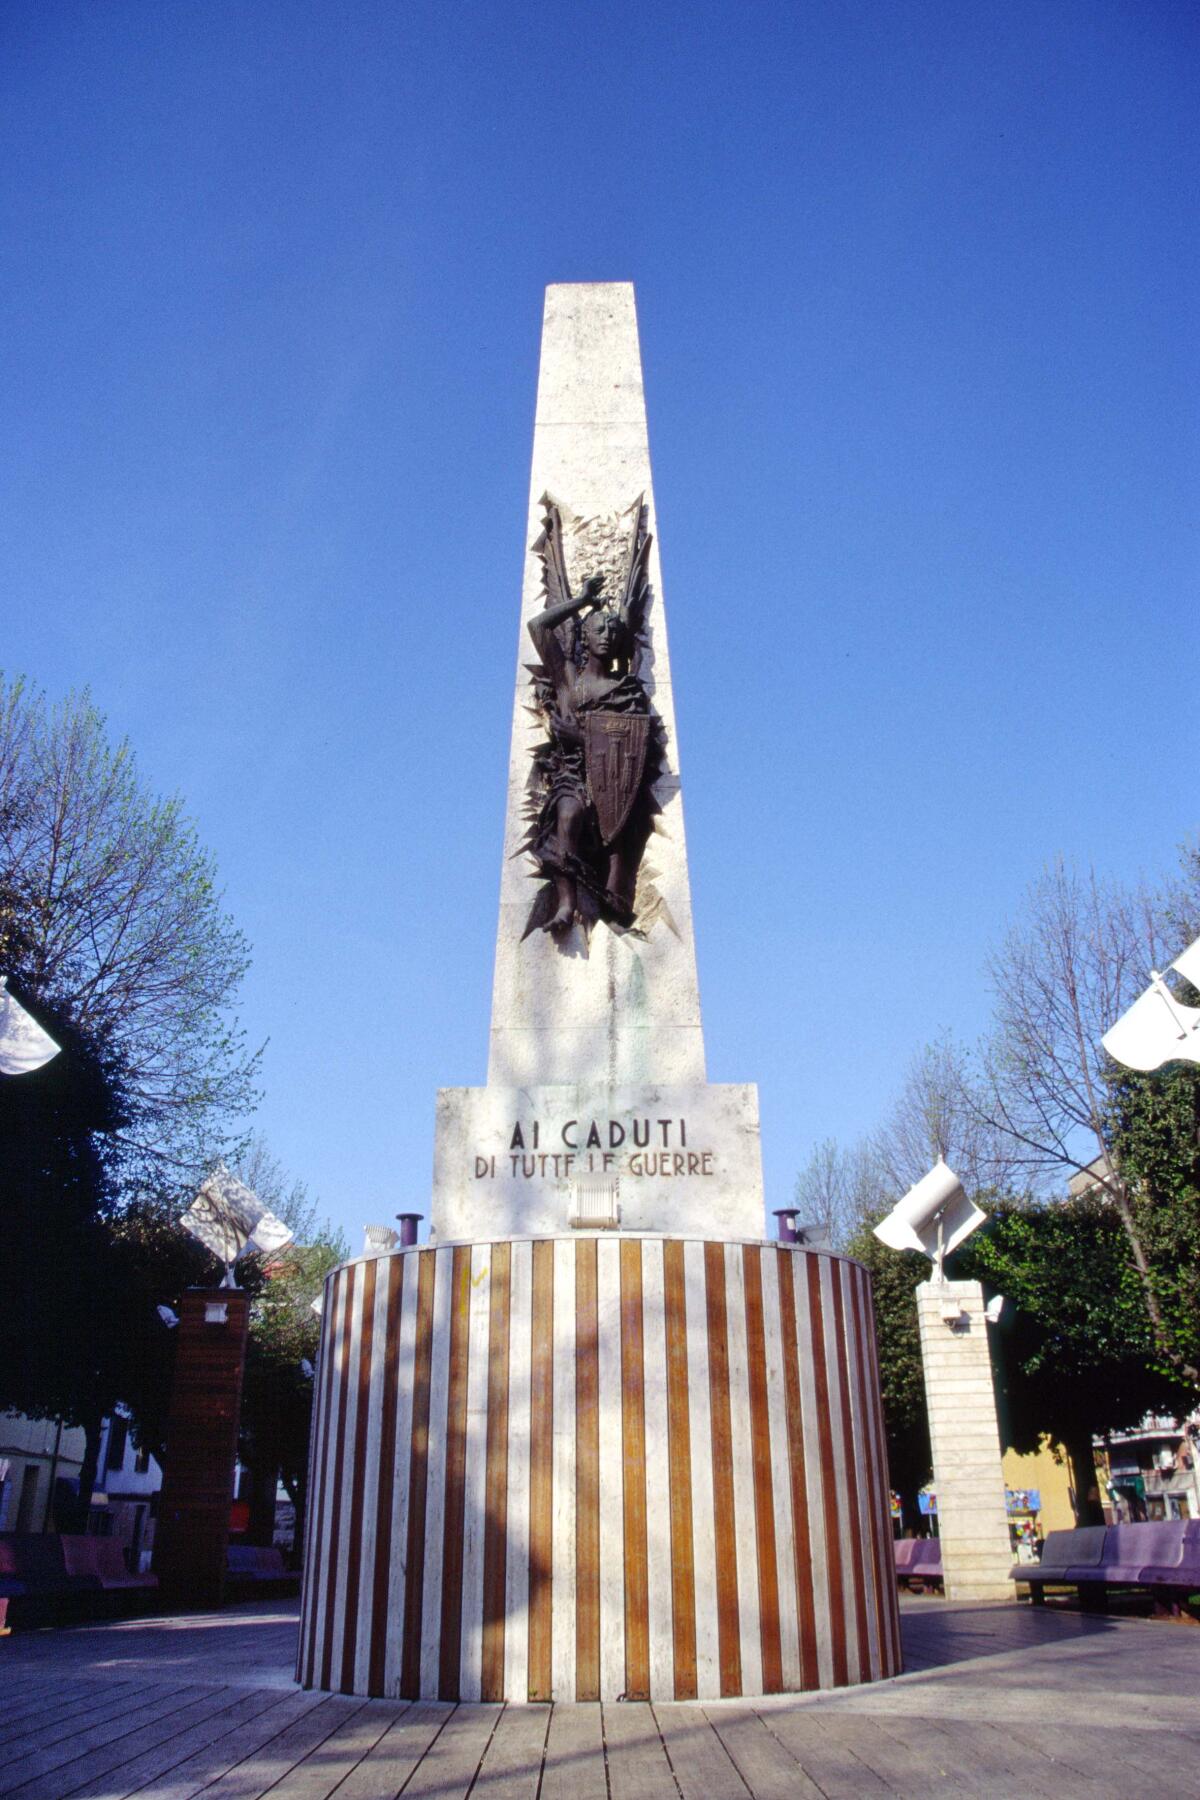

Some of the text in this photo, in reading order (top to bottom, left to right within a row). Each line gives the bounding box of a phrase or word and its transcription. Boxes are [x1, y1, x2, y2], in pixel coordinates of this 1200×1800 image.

[509, 1118, 687, 1150] AI CADUTI
[474, 1155, 496, 1179] DI
[628, 1151, 714, 1177] GUERRE
